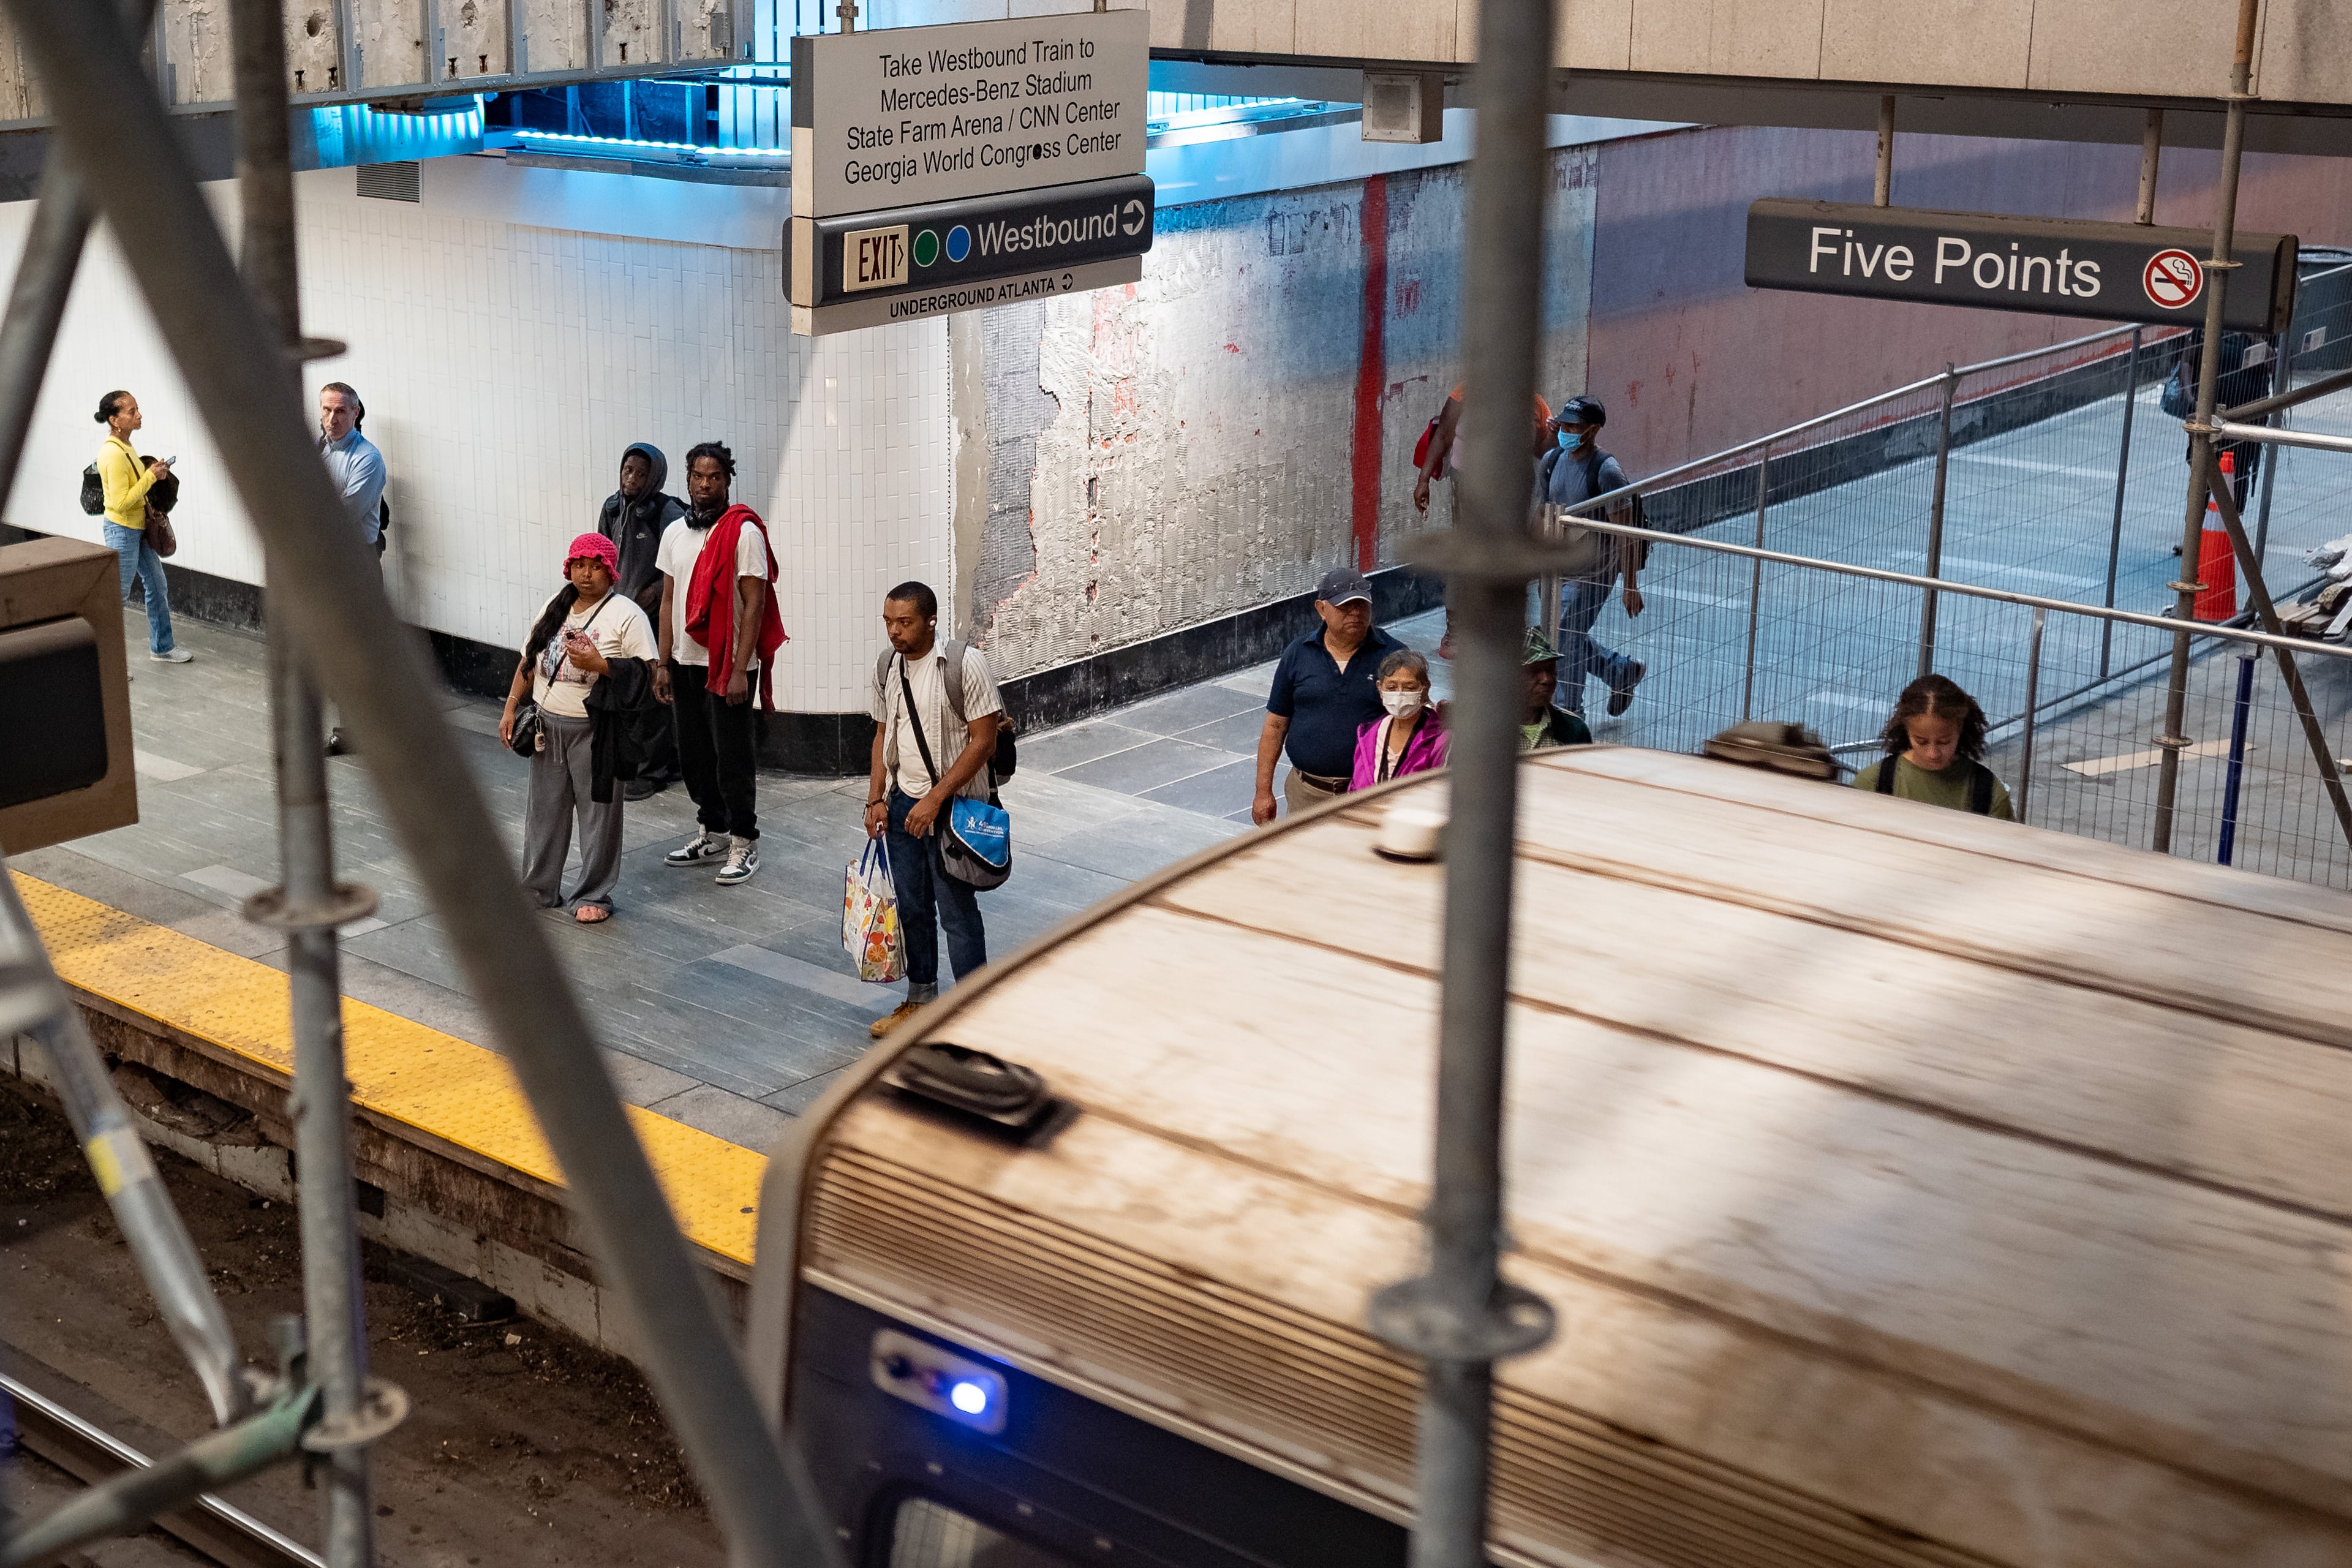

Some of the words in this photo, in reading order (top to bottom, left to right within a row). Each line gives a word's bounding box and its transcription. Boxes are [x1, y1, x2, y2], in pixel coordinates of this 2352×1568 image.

[880, 54, 922, 78] Take
[929, 44, 1027, 73] Westbound
[1033, 39, 1074, 62] Train
[1079, 38, 1095, 58] to
[881, 78, 1020, 112] Mercedes-Benz
[1025, 70, 1091, 96] Stadium
[847, 124, 894, 150] State
[900, 121, 946, 144] Farm
[951, 115, 1003, 138] Arena
[1008, 108, 1015, 132] /
[1020, 103, 1060, 130] CNN
[1065, 99, 1121, 124] Center
[845, 155, 917, 185] Georgia
[923, 146, 974, 174] World
[981, 141, 1061, 168] Congrss
[1066, 130, 1121, 156] Center
[978, 205, 1117, 256] Westbound
[859, 233, 900, 283] EXIT
[1810, 227, 1914, 281] Five
[1934, 236, 2101, 297] Points
[890, 287, 995, 318] UNDERGROUND
[997, 277, 1055, 301] ATLANTA
